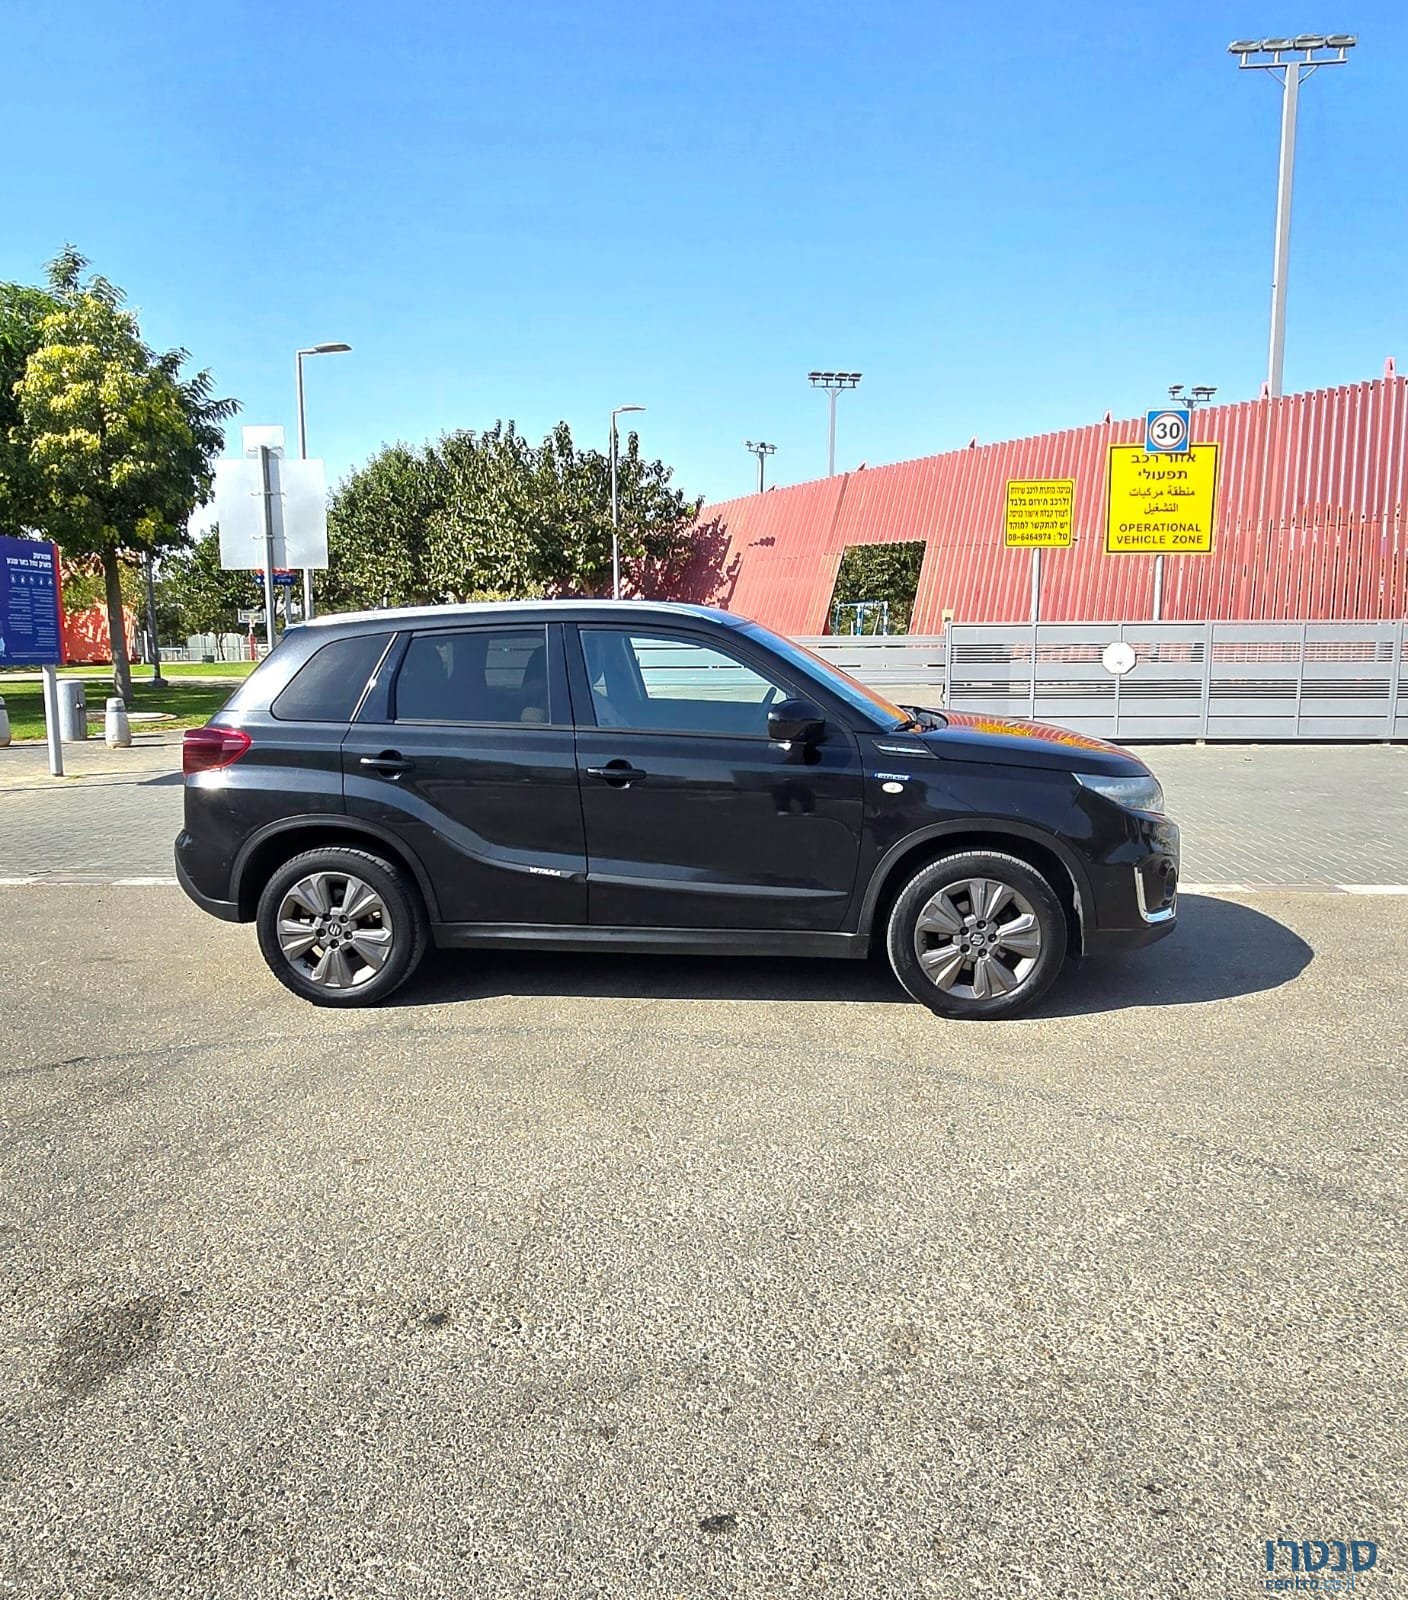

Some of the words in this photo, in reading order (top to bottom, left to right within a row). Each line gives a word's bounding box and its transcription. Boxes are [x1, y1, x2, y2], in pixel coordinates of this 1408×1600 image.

[1156, 422, 1181, 439] 30
[1131, 454, 1159, 463] רכב
[1165, 453, 1196, 463] אזור
[1138, 469, 1188, 480] תפעולי
[1129, 487, 1164, 499] مركبات
[1167, 485, 1195, 496] منطقة
[1010, 497, 1026, 506] בלבד
[1050, 498, 1069, 506] ולרכב
[1144, 503, 1178, 515] التشغيل
[1009, 521, 1028, 531] למוקד
[1031, 520, 1058, 530] להתקשר
[1060, 521, 1068, 529] יש
[1119, 523, 1202, 532] OPERATIONAL
[1116, 535, 1166, 544] VEHICLE
[1172, 535, 1204, 544] ZONE
